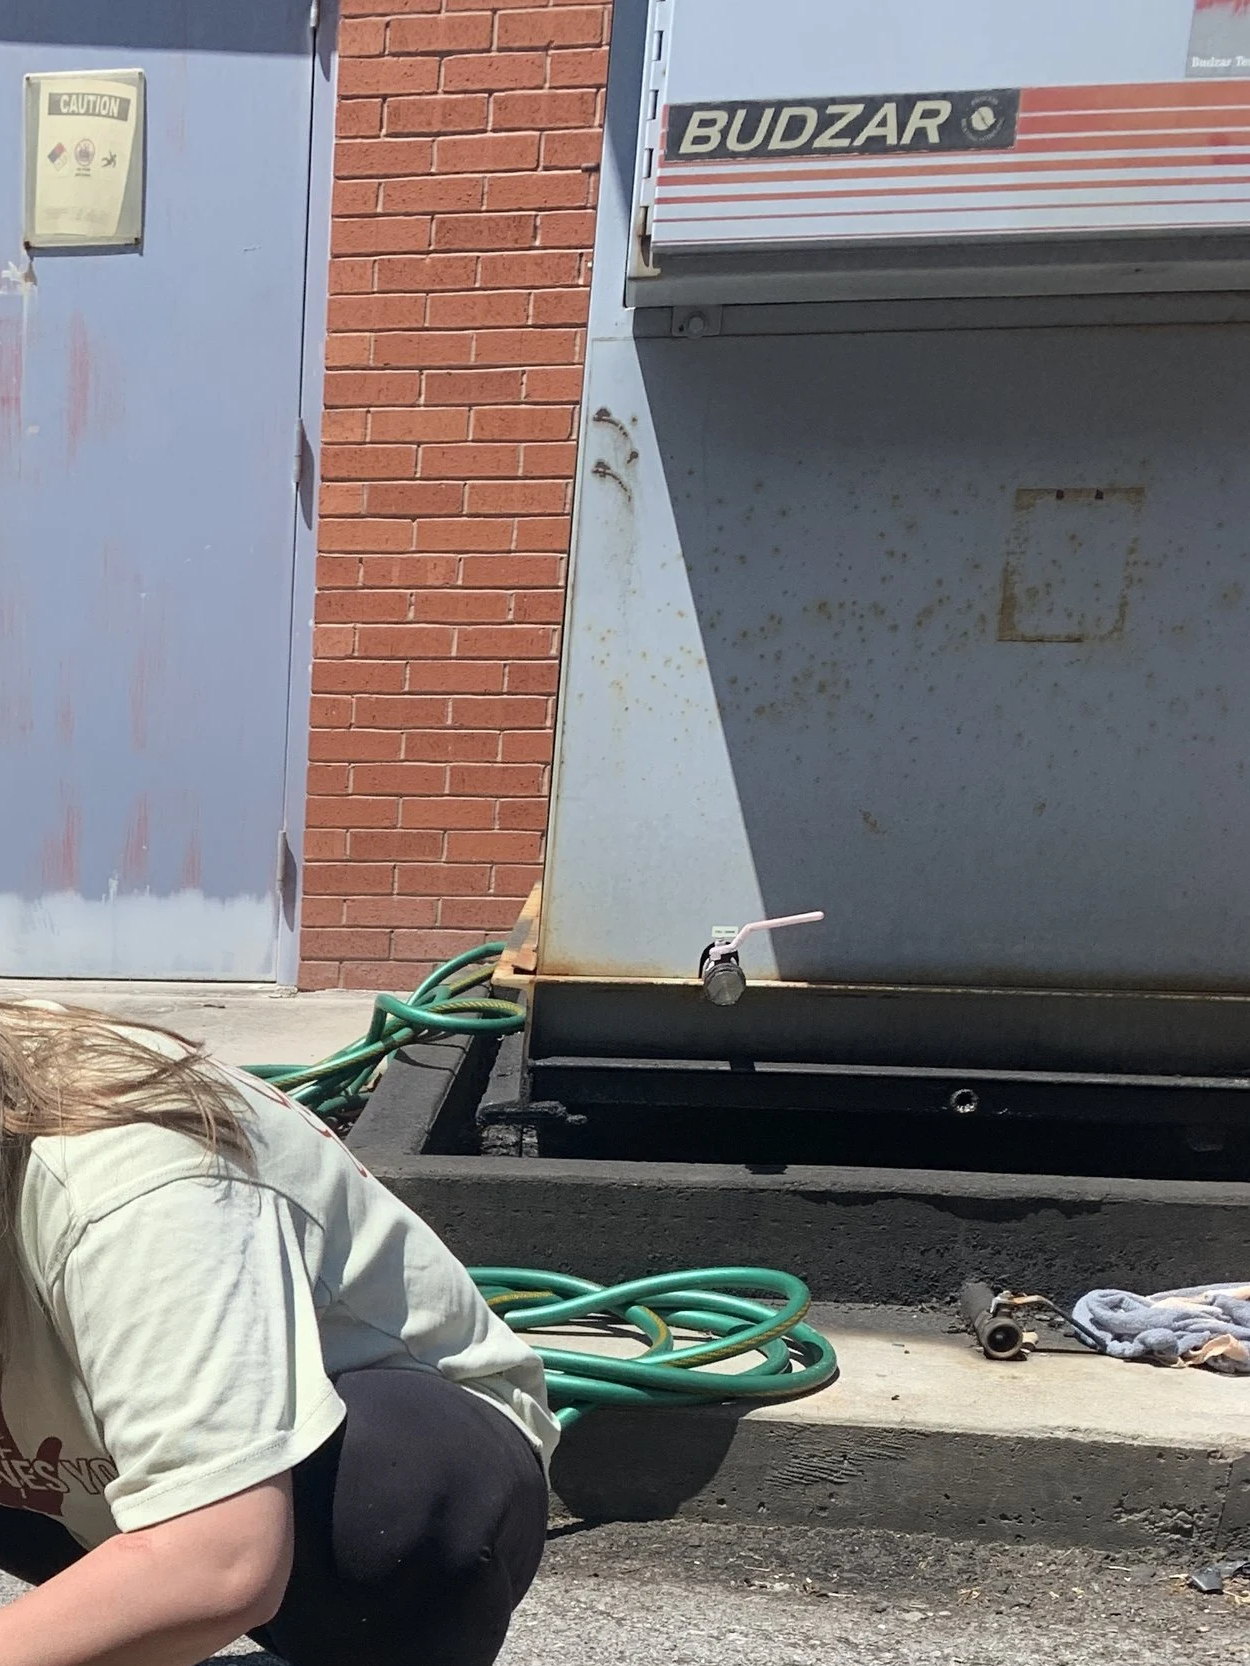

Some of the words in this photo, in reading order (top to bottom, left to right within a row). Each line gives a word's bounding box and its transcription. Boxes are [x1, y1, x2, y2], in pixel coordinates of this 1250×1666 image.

[60, 94, 120, 117] CAUTION
[678, 99, 952, 154] BUDZAR
[59, 1457, 119, 1495] YO
